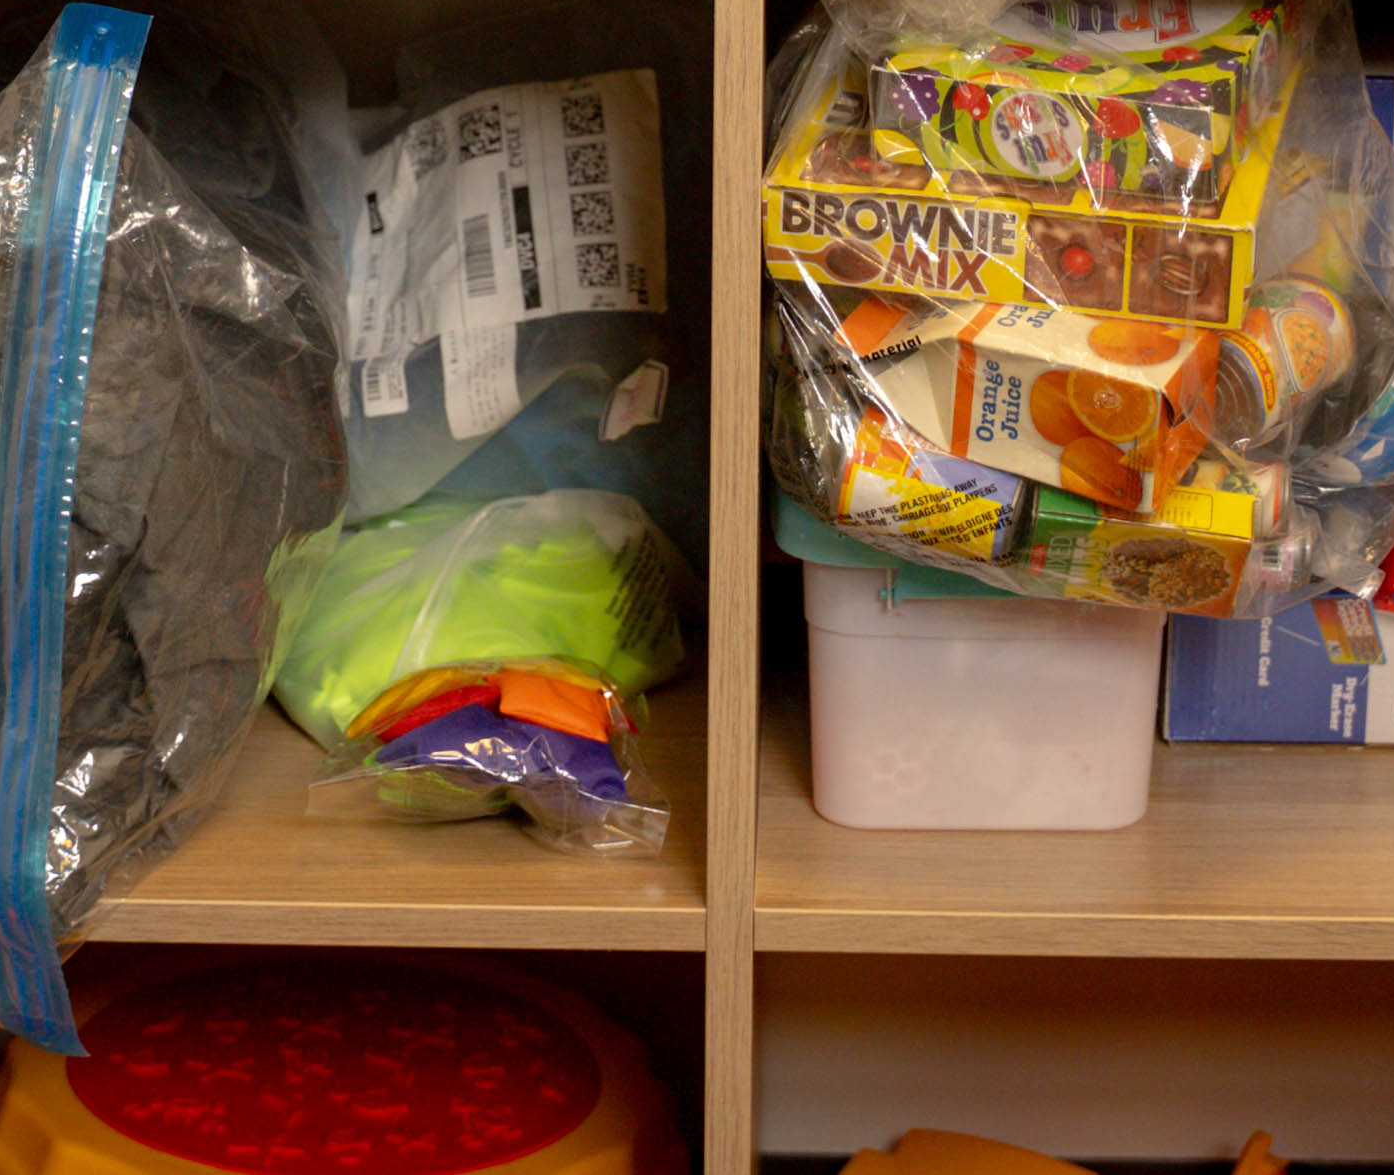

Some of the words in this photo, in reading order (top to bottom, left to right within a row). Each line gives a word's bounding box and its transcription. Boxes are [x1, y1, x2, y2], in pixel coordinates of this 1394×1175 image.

[780, 188, 1018, 256] BROWNIE
[882, 241, 990, 296] MIX
[974, 358, 1002, 444] Orange
[1000, 374, 1023, 441] Juice
[953, 477, 977, 494] AWAY
[953, 483, 998, 508] PLAYPENS
[1259, 616, 1273, 654] Credit
[1258, 656, 1271, 687] Card
[1329, 684, 1344, 731] Marker
[1343, 677, 1358, 738] Dry-Erase
